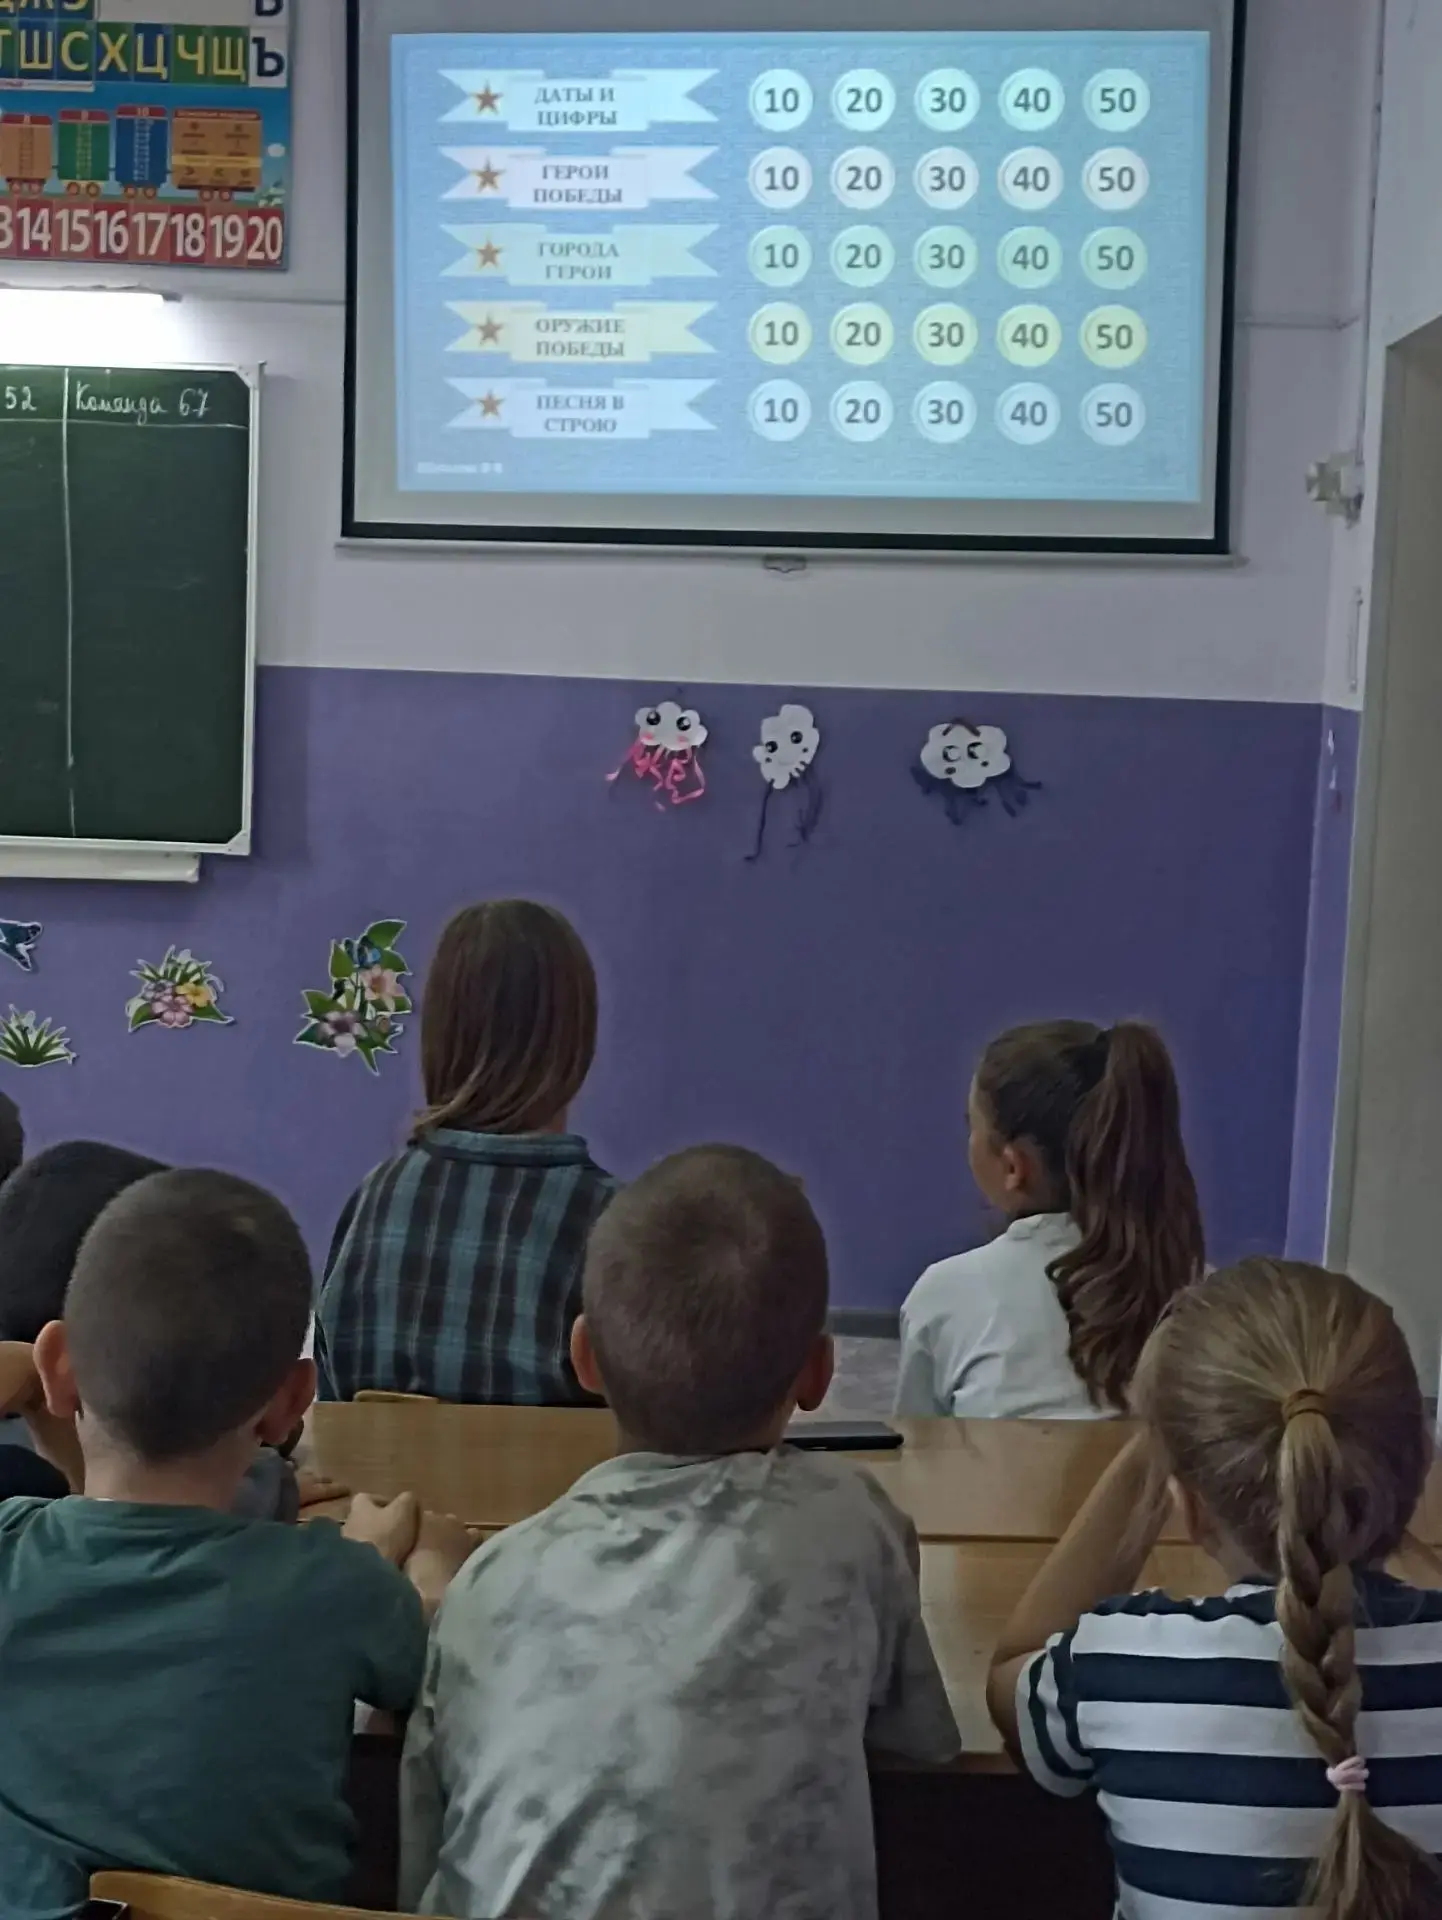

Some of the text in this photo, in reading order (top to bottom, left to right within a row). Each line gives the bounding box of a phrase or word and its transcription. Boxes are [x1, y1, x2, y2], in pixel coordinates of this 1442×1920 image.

[535, 88, 615, 104] ДАТЫ И
[764, 87, 1136, 113] 10 20 30 40 50
[537, 110, 618, 127] ЦИФРЫ
[542, 165, 609, 180] ГЕРОИ
[764, 166, 1135, 192] 10 20 30 40 50
[533, 188, 622, 204] ПОБЕДЫ
[17, 207, 52, 251] 14
[55, 208, 90, 252] 15
[94, 210, 129, 254] 16
[132, 212, 168, 256] 17
[170, 213, 206, 257] 18
[210, 214, 244, 258] 19
[247, 217, 284, 260] 20
[538, 242, 619, 258] ГОРОДА
[764, 244, 1134, 271] 10 20 30 40 50
[545, 265, 612, 280] ГЕРОИ
[535, 318, 625, 334] ОРУЖИЕ
[764, 321, 1133, 349] 10 20 30 40 50
[536, 341, 625, 358] ПОБЕДЫ
[5, 386, 37, 411] 52
[75, 380, 209, 425] Команда 67
[537, 395, 624, 410] ПЕСНЯ В
[764, 398, 1133, 427] 10 20 30 40 50
[544, 418, 617, 433] СТРОЮ
